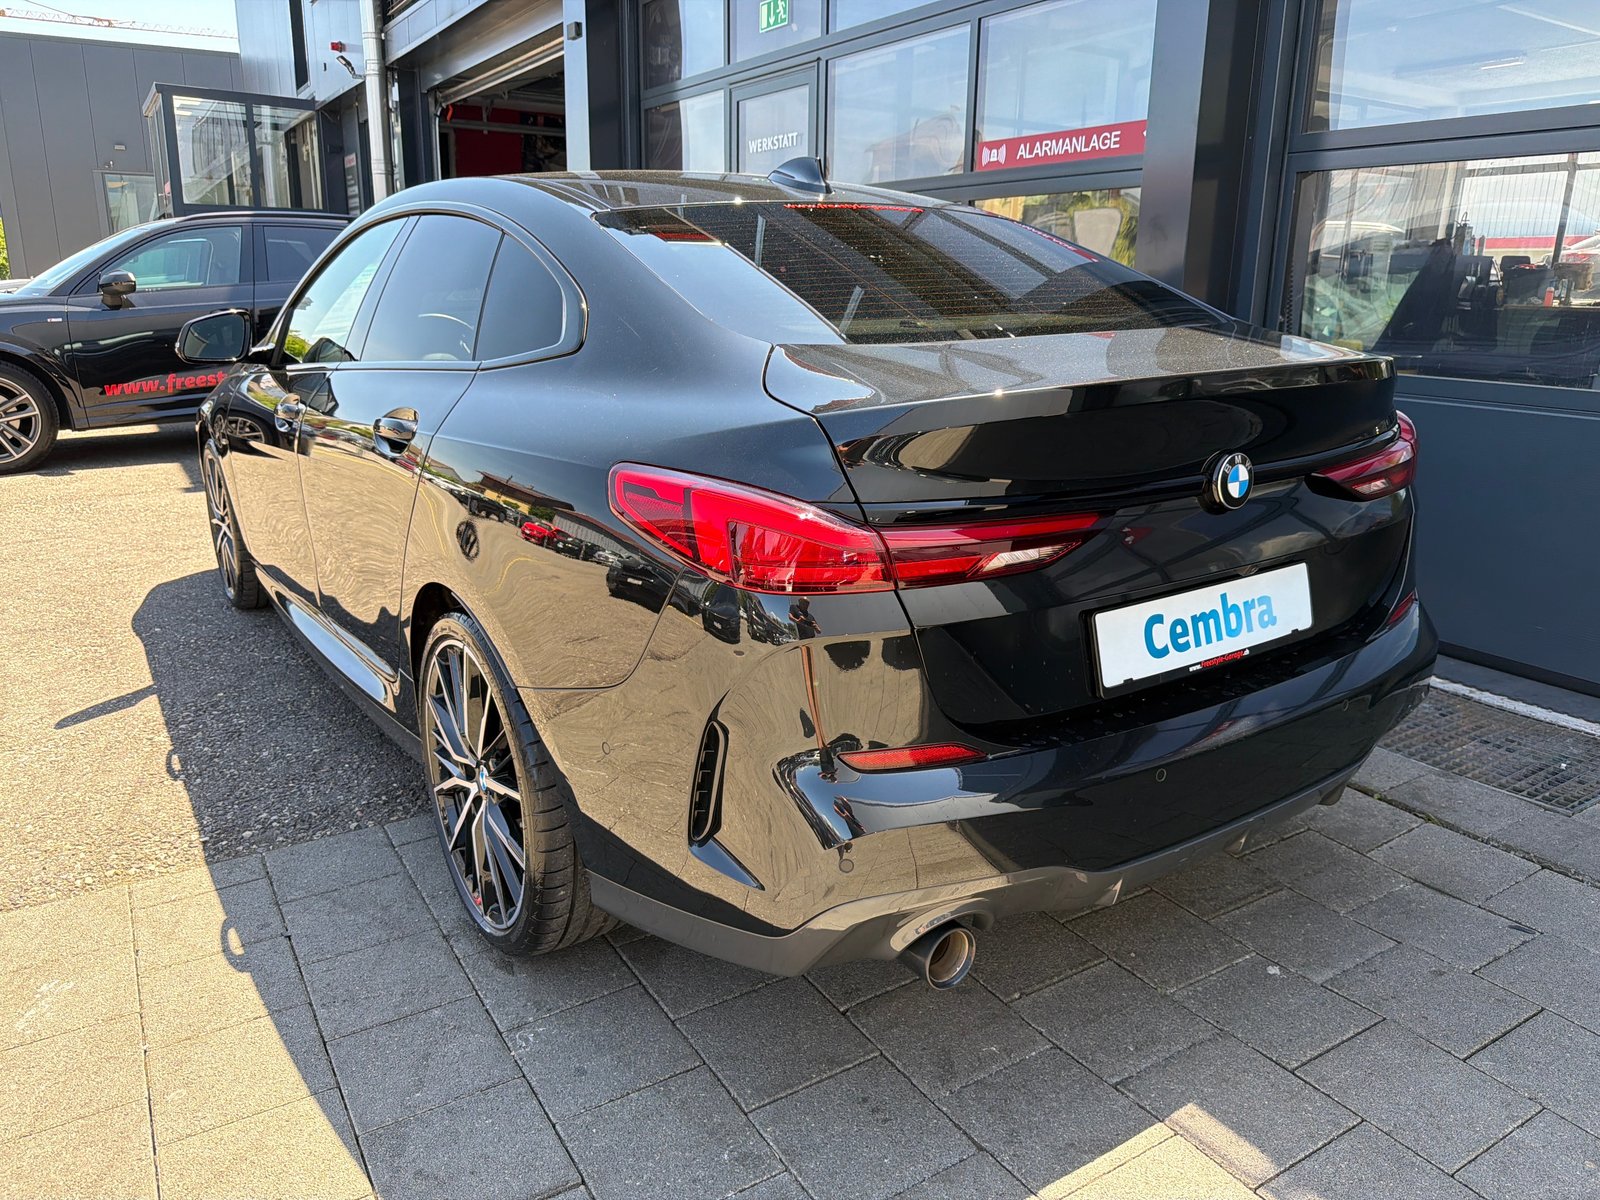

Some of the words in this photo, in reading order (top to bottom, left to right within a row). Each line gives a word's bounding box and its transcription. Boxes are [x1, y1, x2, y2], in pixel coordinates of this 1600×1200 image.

[748, 132, 798, 154] WERKSTATT
[1016, 131, 1121, 159] ALARMANLAGE
[1224, 454, 1252, 474] BMW
[1144, 592, 1277, 659] Cembra
